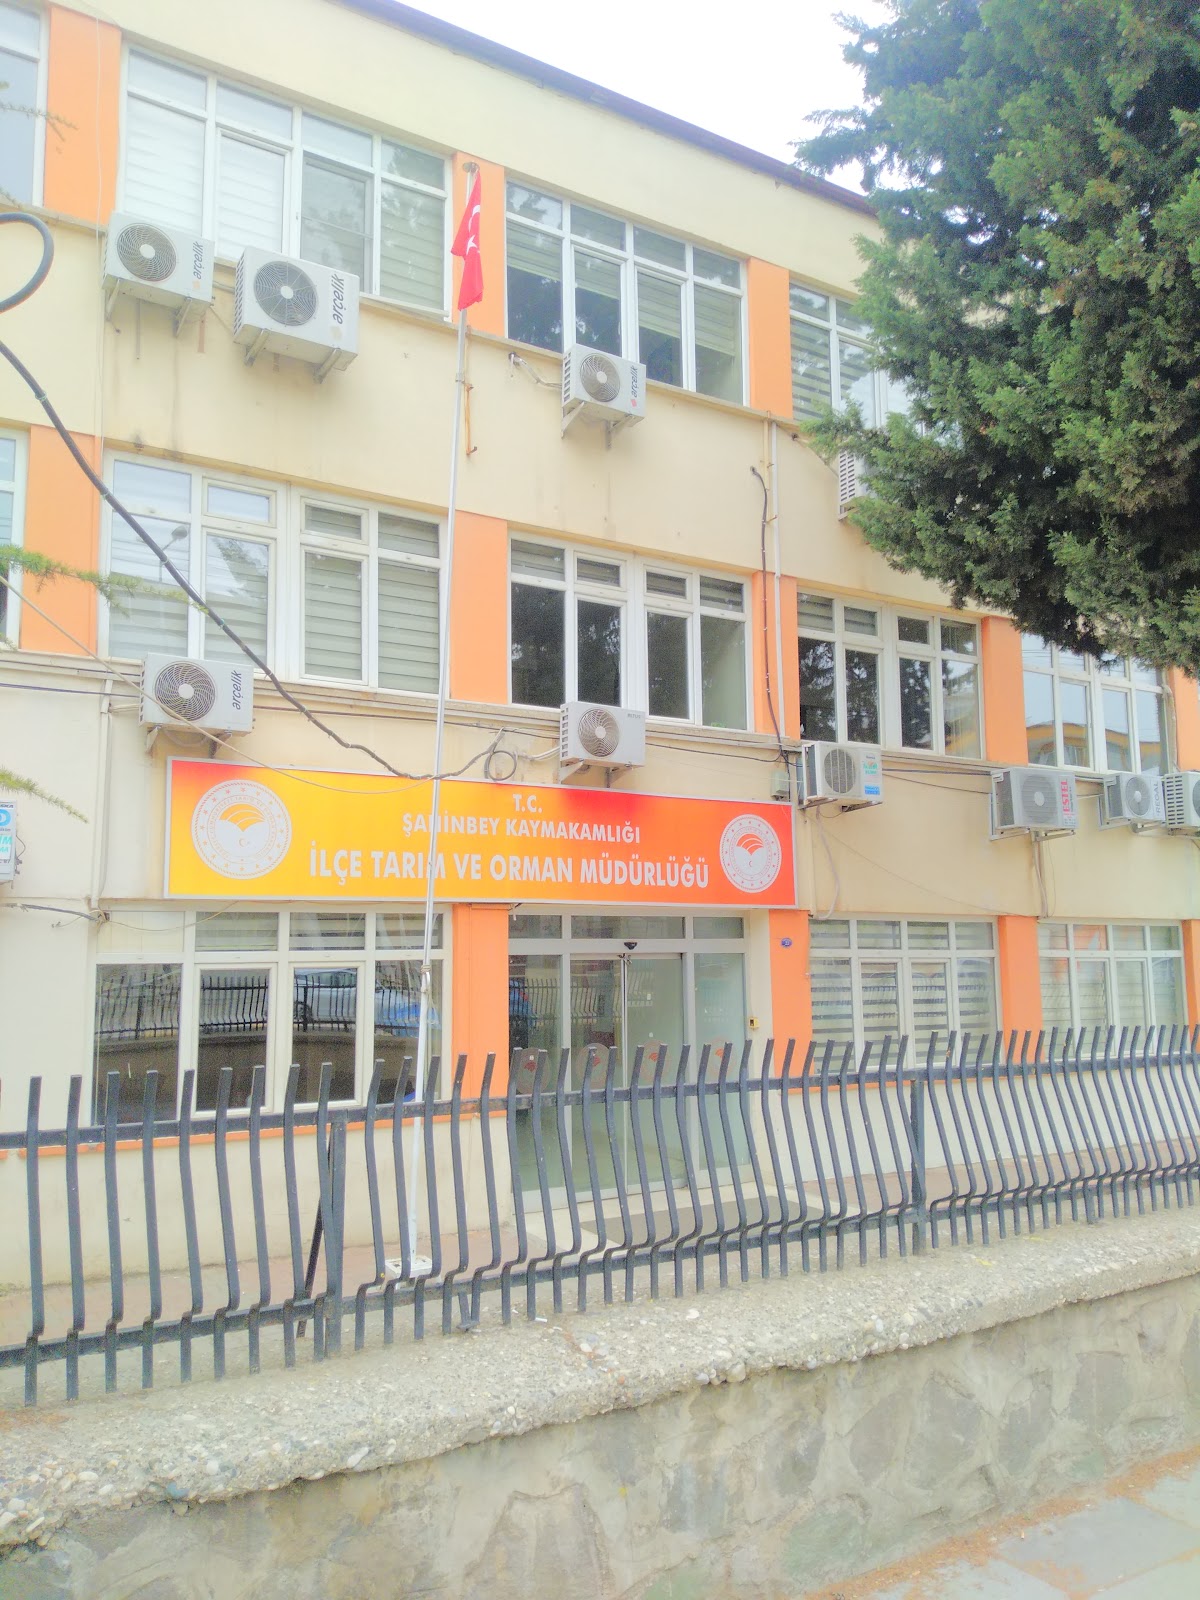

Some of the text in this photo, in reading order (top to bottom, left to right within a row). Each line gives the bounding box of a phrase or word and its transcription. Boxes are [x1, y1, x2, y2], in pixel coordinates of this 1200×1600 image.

[192, 240, 204, 280] arçelik
[330, 273, 346, 325] arçelik
[230, 669, 244, 710] arçelik
[513, 793, 543, 813] T.C.
[506, 818, 640, 844] KAYMAKAMLIĞI
[309, 840, 362, 885] İLÇE
[371, 849, 446, 881] TARIM
[453, 853, 482, 880] VE
[490, 854, 573, 883] ORMAN
[581, 852, 709, 889] MÜDÜRLÜĞÜ
